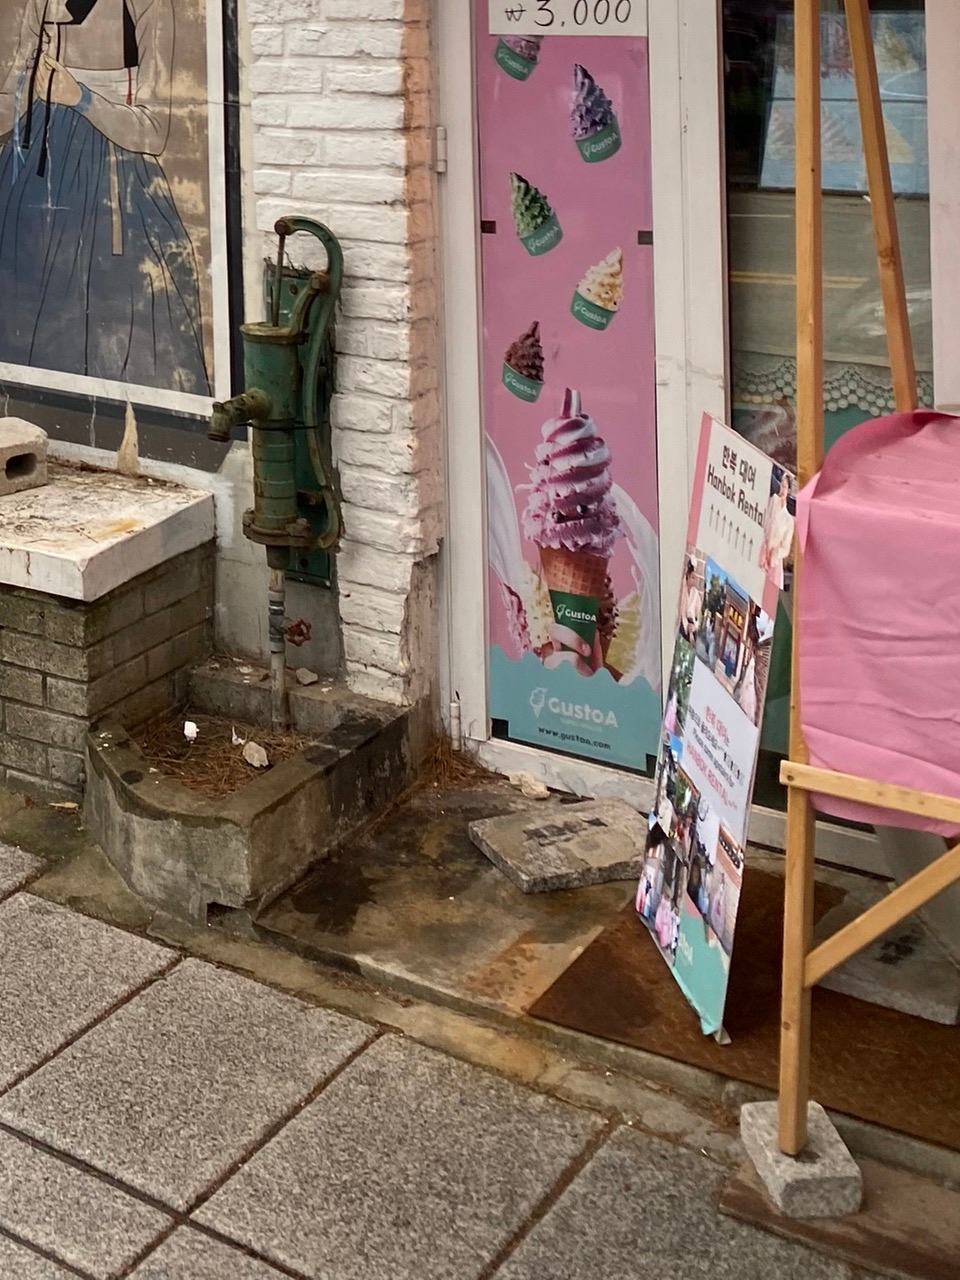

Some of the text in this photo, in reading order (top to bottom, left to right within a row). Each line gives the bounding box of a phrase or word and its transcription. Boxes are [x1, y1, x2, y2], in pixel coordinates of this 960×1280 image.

[706, 463, 736, 505] Hanbok
[722, 445, 757, 491] 한복 대여
[537, 726, 612, 751] www.gustoa.com
